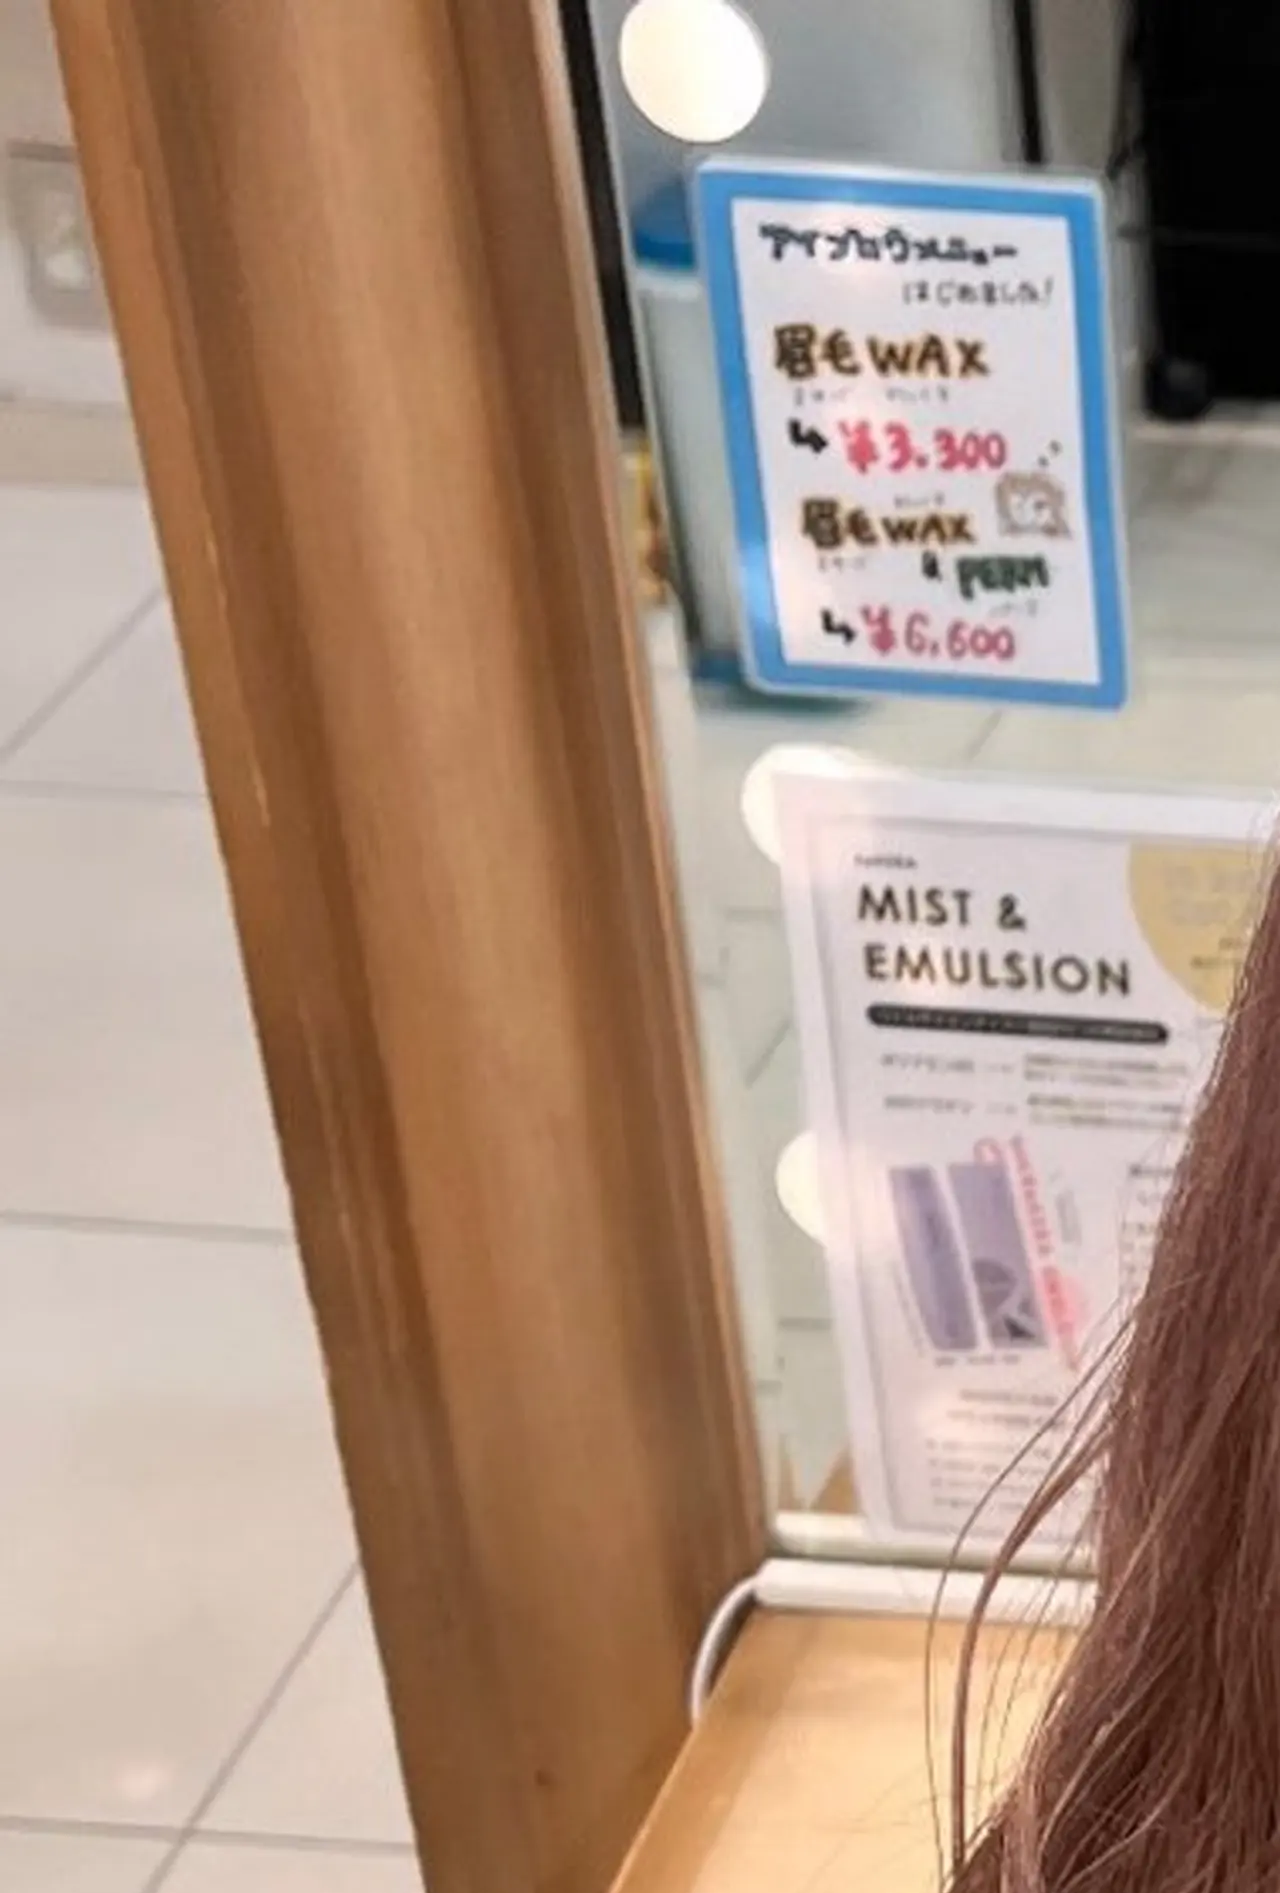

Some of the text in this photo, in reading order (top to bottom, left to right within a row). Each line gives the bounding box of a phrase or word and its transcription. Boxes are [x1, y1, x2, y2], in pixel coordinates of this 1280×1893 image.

[858, 884, 1027, 932] MIST &
[864, 942, 1130, 998] EMULSION
